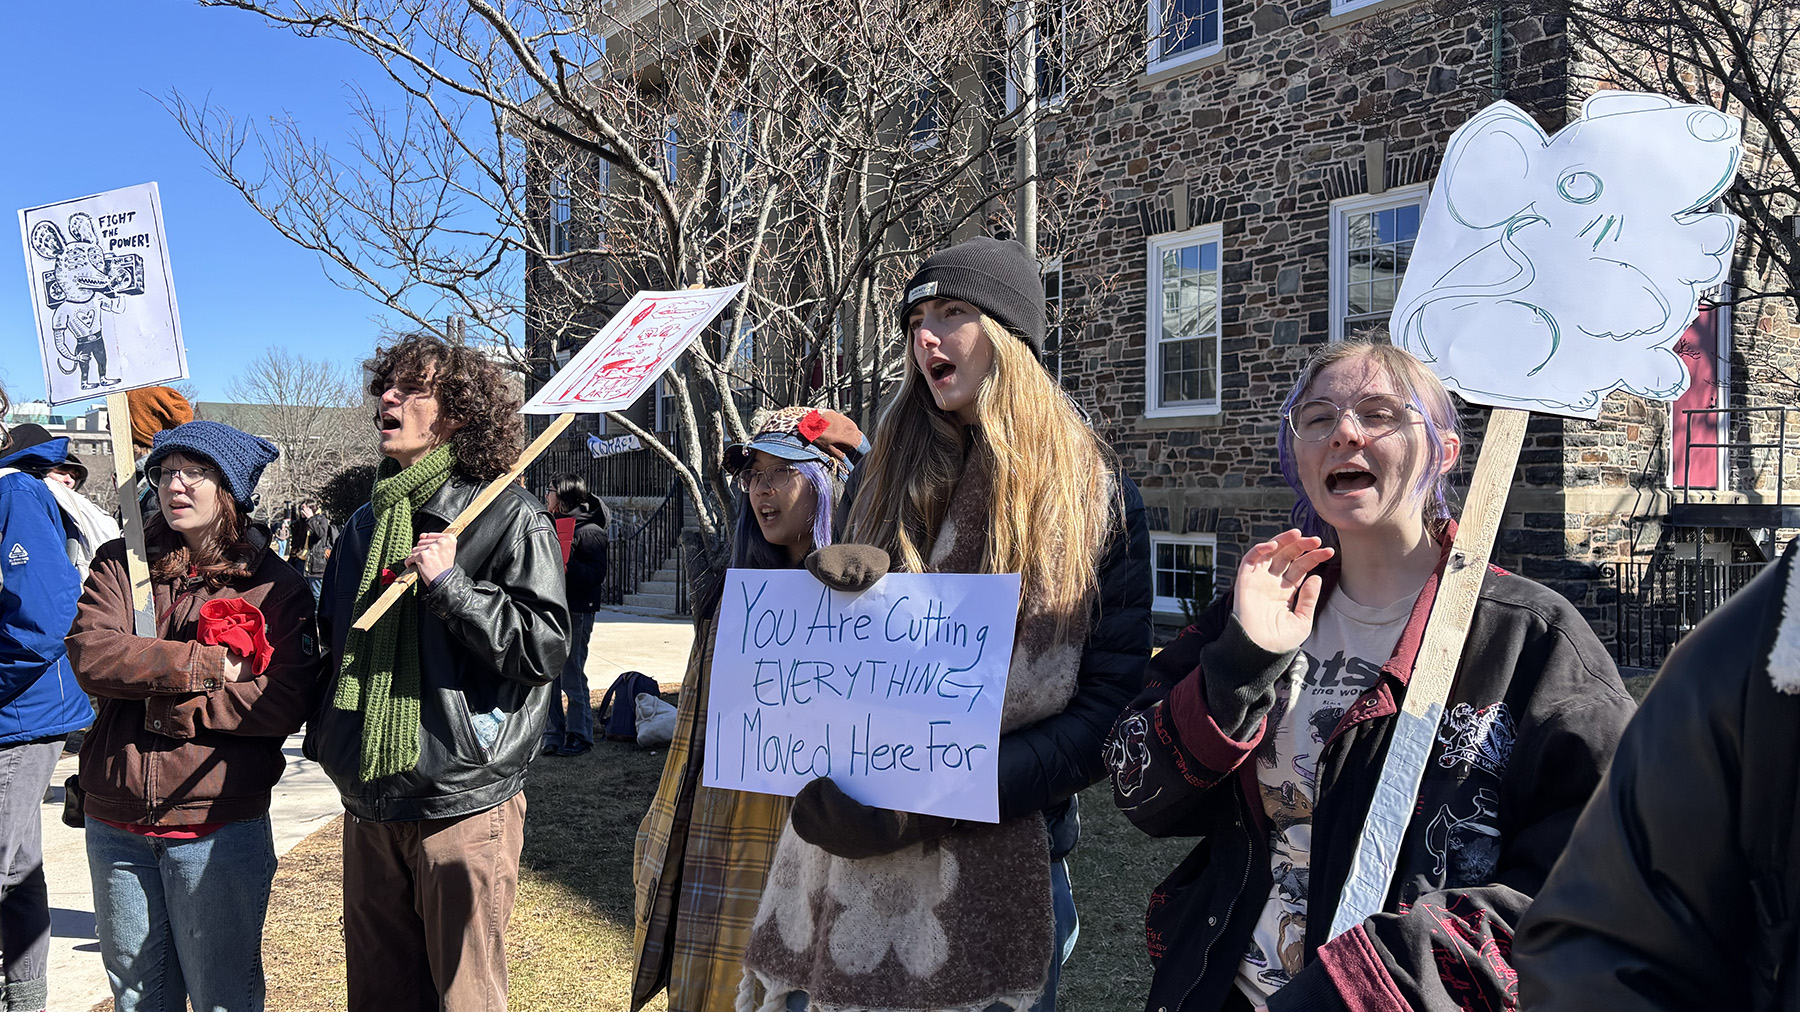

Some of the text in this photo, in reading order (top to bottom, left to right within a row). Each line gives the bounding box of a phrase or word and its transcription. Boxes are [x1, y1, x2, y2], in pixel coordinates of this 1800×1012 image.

[98, 211, 136, 228] FIGHT
[102, 227, 118, 238] THE
[109, 233, 150, 251] POWER!
[806, 585, 872, 645] Are
[885, 596, 989, 672] Cutting
[1311, 687, 1334, 696] the
[715, 707, 987, 782] I Moved Here For
